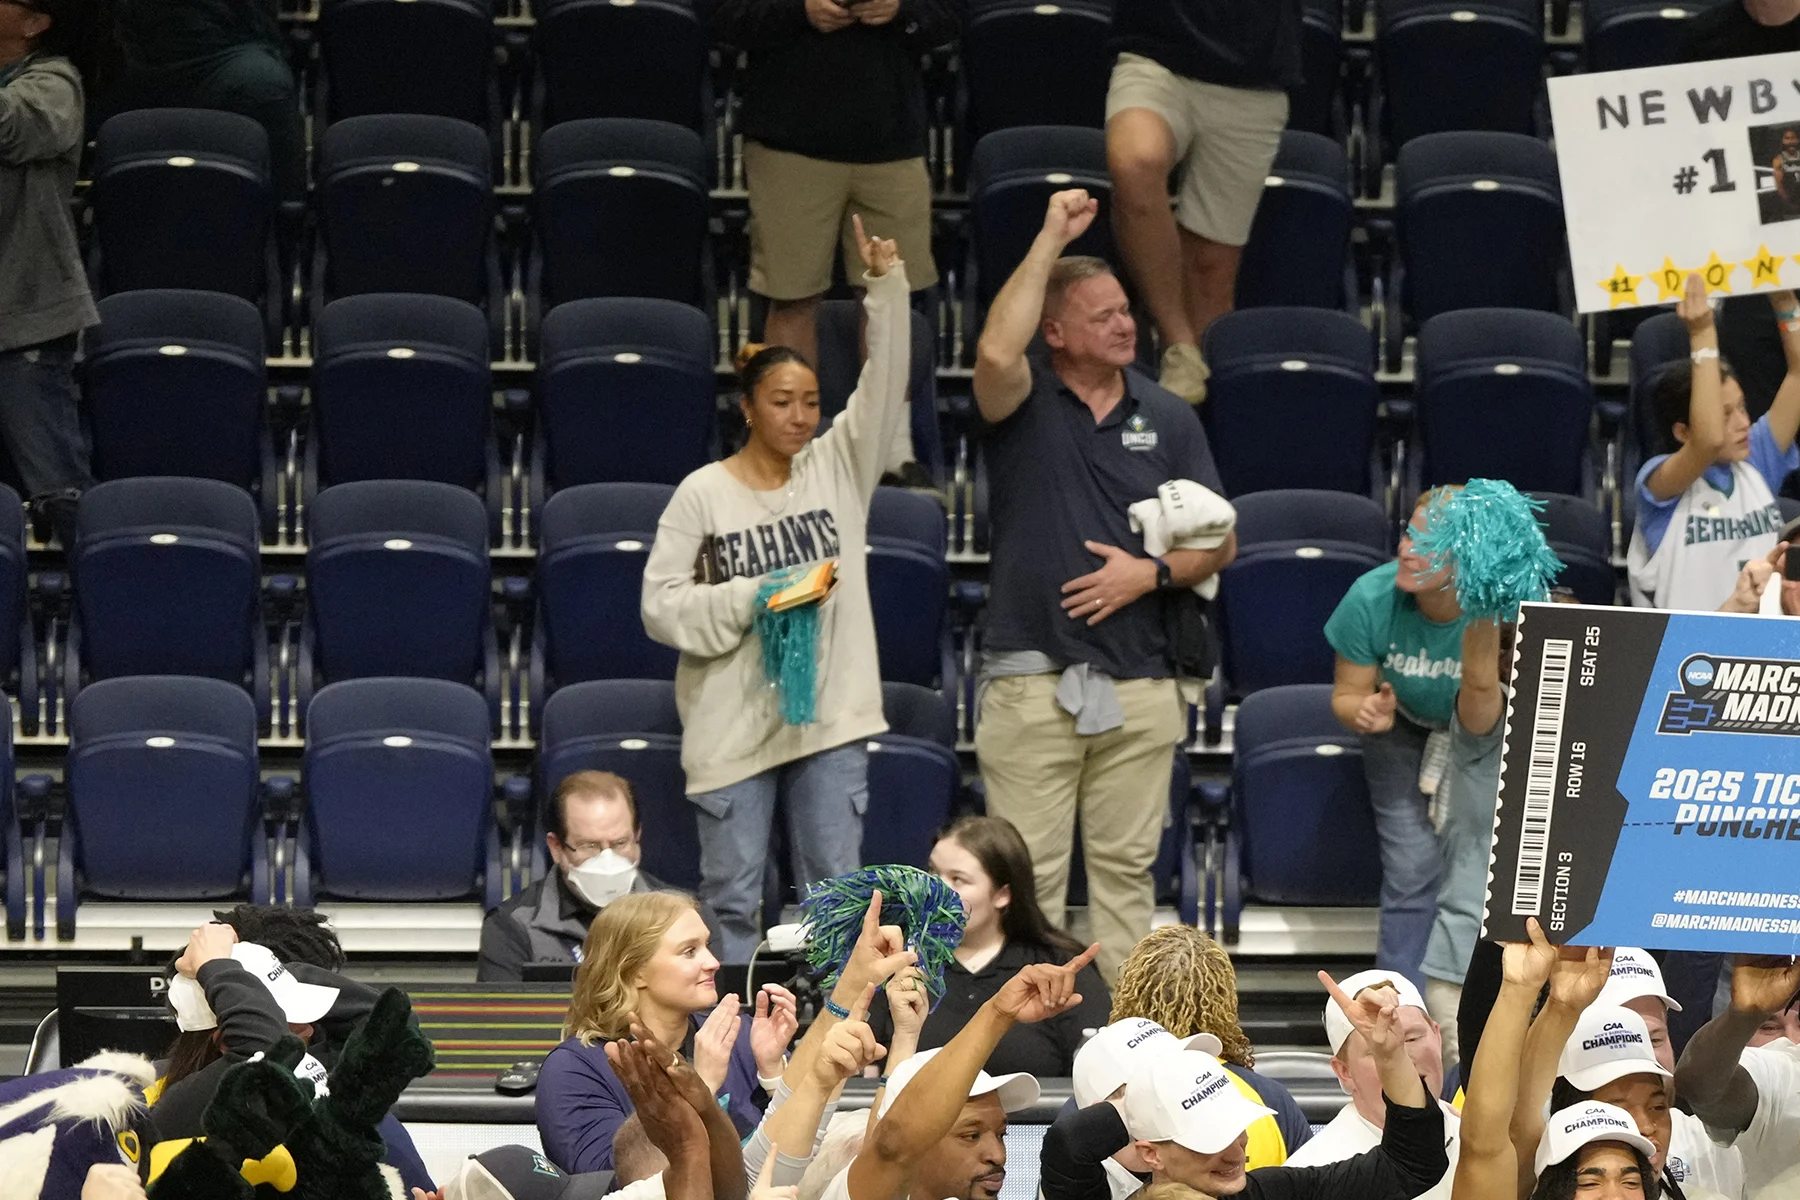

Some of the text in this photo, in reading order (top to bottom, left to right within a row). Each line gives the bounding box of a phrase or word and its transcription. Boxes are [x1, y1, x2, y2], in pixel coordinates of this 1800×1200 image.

[1672, 148, 1736, 195] #1
[715, 508, 841, 583] SEAHAWKS
[1580, 626, 1601, 686] SEAT 25
[1687, 671, 1713, 682] NCAA
[1566, 741, 1587, 798] ROW 16
[1649, 767, 1745, 802] 2025
[1550, 851, 1573, 931] SECTION 3
[1610, 966, 1655, 979] AMPIONS
[1583, 1033, 1643, 1051] CHAMPIONS
[1603, 1023, 1624, 1033] CAA
[1181, 1075, 1230, 1110] CHAMPIONS
[1196, 1071, 1212, 1084] CAA
[1564, 1117, 1629, 1134] CHAMPIONS
